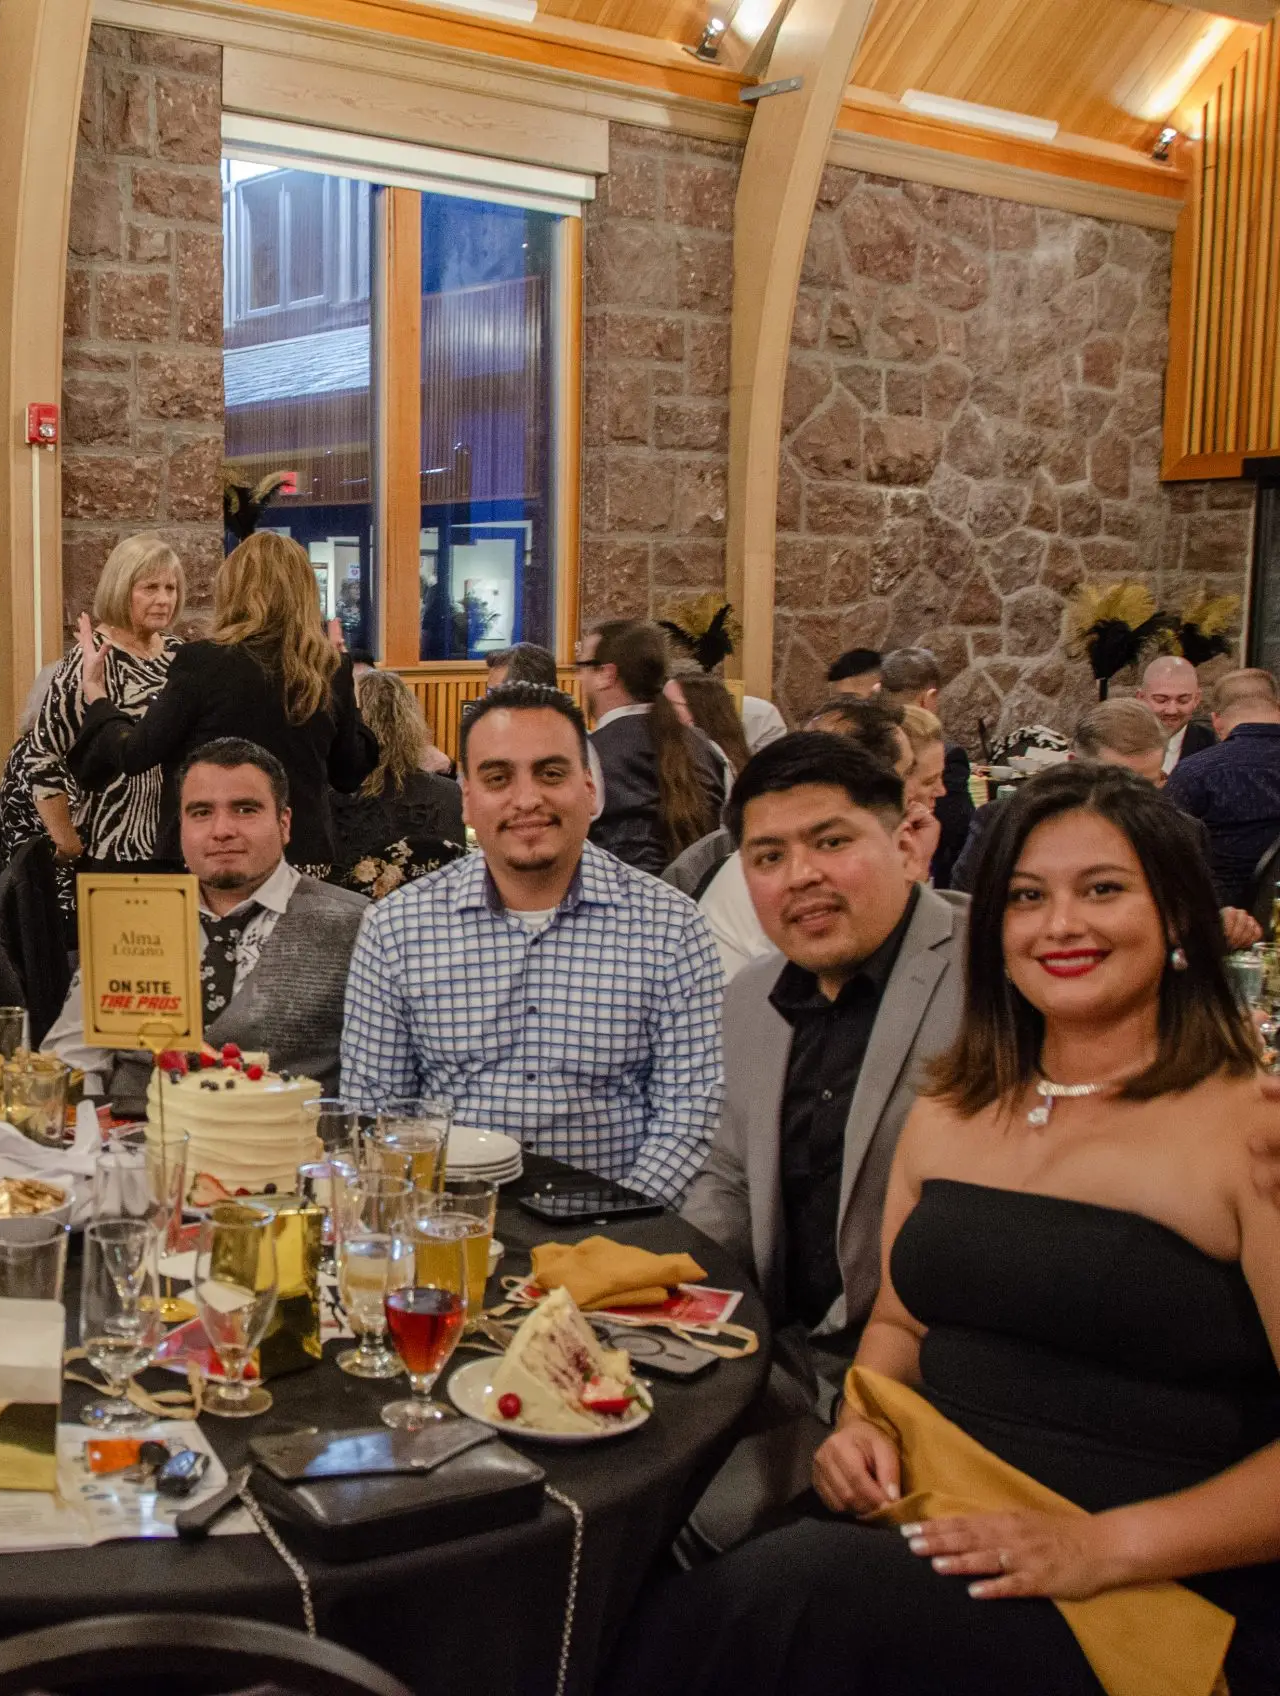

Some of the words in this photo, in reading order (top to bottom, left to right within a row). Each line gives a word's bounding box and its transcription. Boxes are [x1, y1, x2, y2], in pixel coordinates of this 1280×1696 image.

[121, 930, 161, 945] Alma
[108, 979, 132, 993] ON
[136, 980, 172, 994] SITE
[100, 994, 133, 1009] TIRE
[136, 996, 182, 1010] PROS
